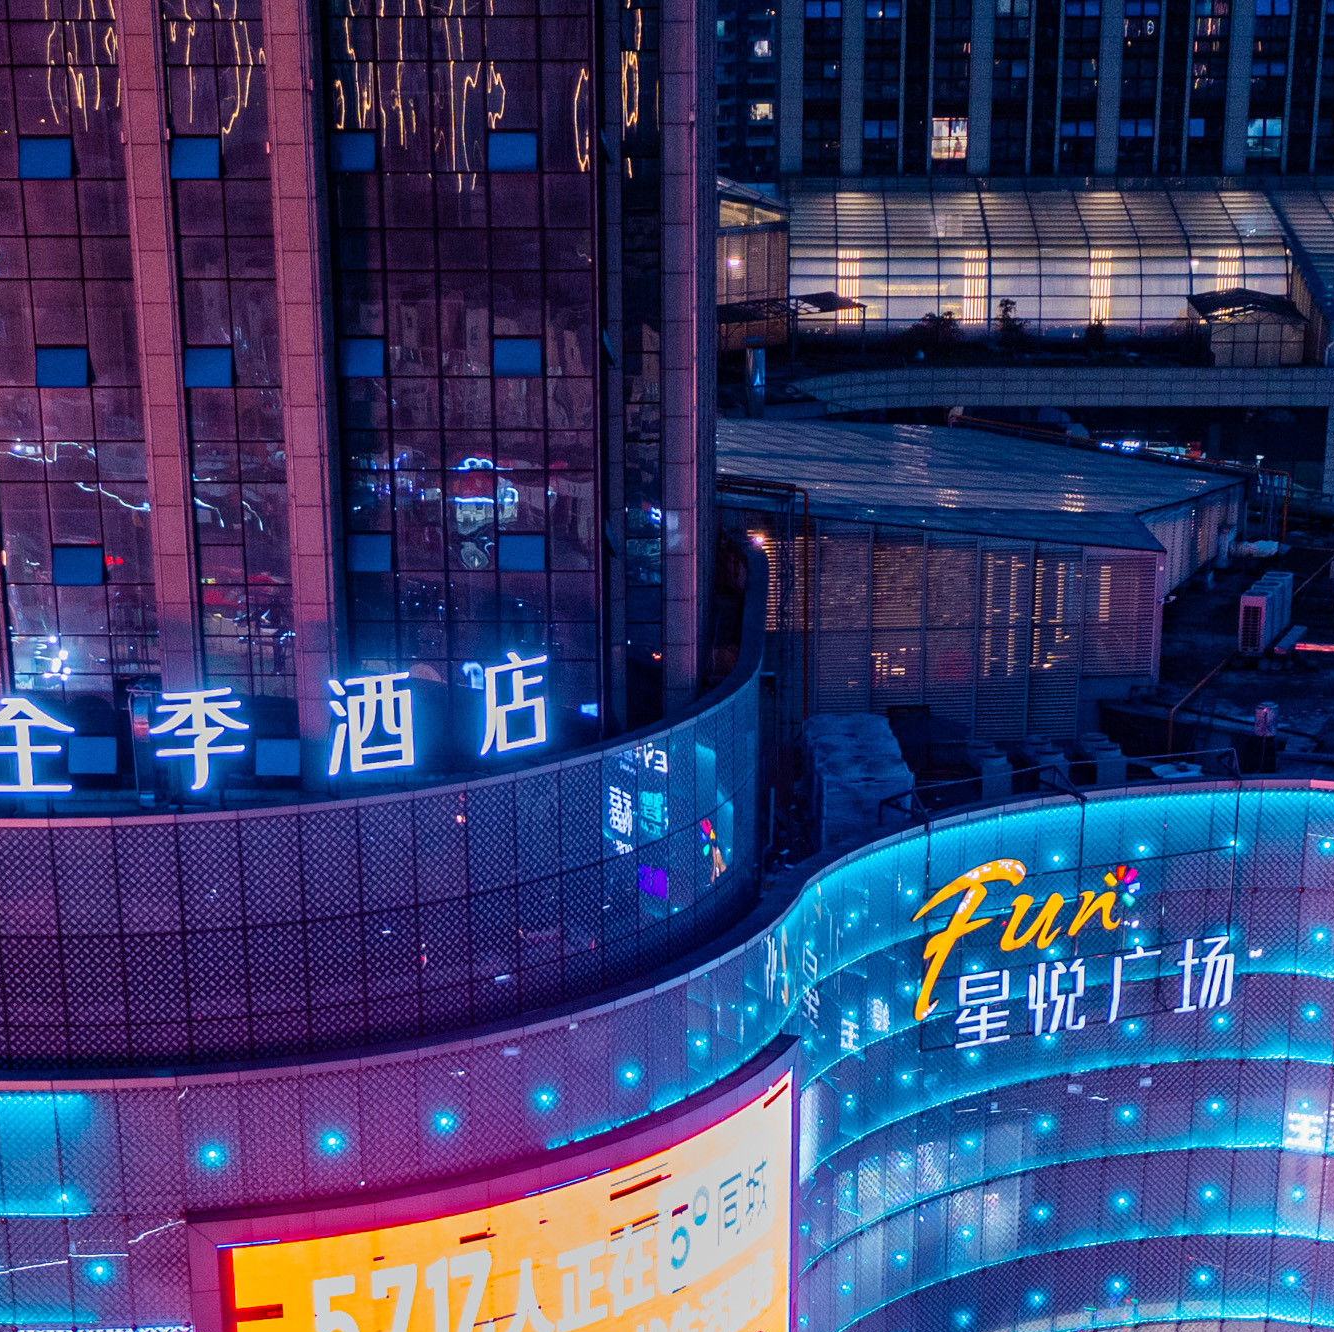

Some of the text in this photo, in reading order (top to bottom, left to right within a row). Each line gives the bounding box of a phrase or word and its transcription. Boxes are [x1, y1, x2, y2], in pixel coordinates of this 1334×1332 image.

[913, 858, 1120, 1021] Fun
[955, 935, 1235, 1049] 星悦广场
